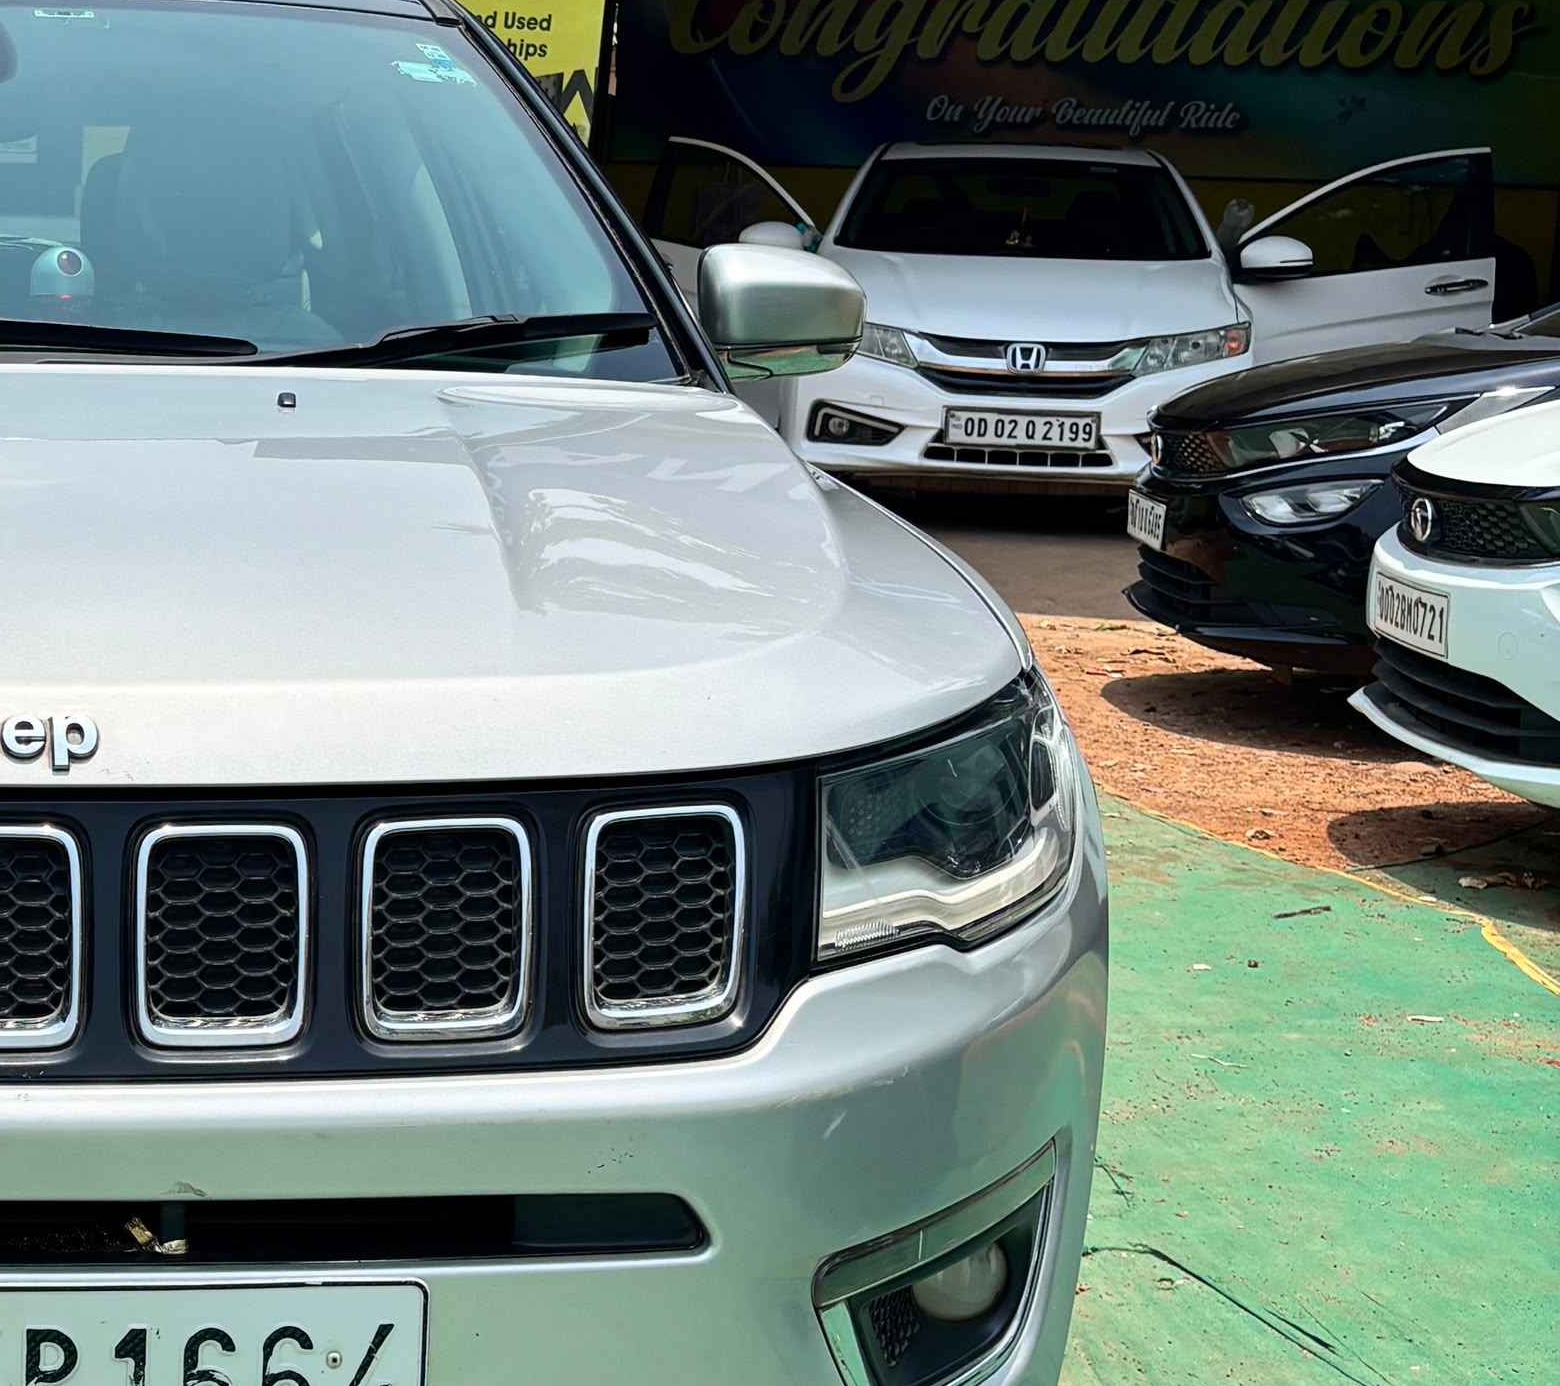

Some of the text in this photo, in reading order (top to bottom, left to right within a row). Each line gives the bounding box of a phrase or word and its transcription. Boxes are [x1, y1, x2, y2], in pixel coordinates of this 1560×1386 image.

[504, 11, 552, 31] Used
[926, 94, 1240, 136] On Your Beautiful Ride
[994, 419, 1018, 439] 02
[1025, 420, 1036, 440] Q
[1042, 420, 1093, 442] 2199
